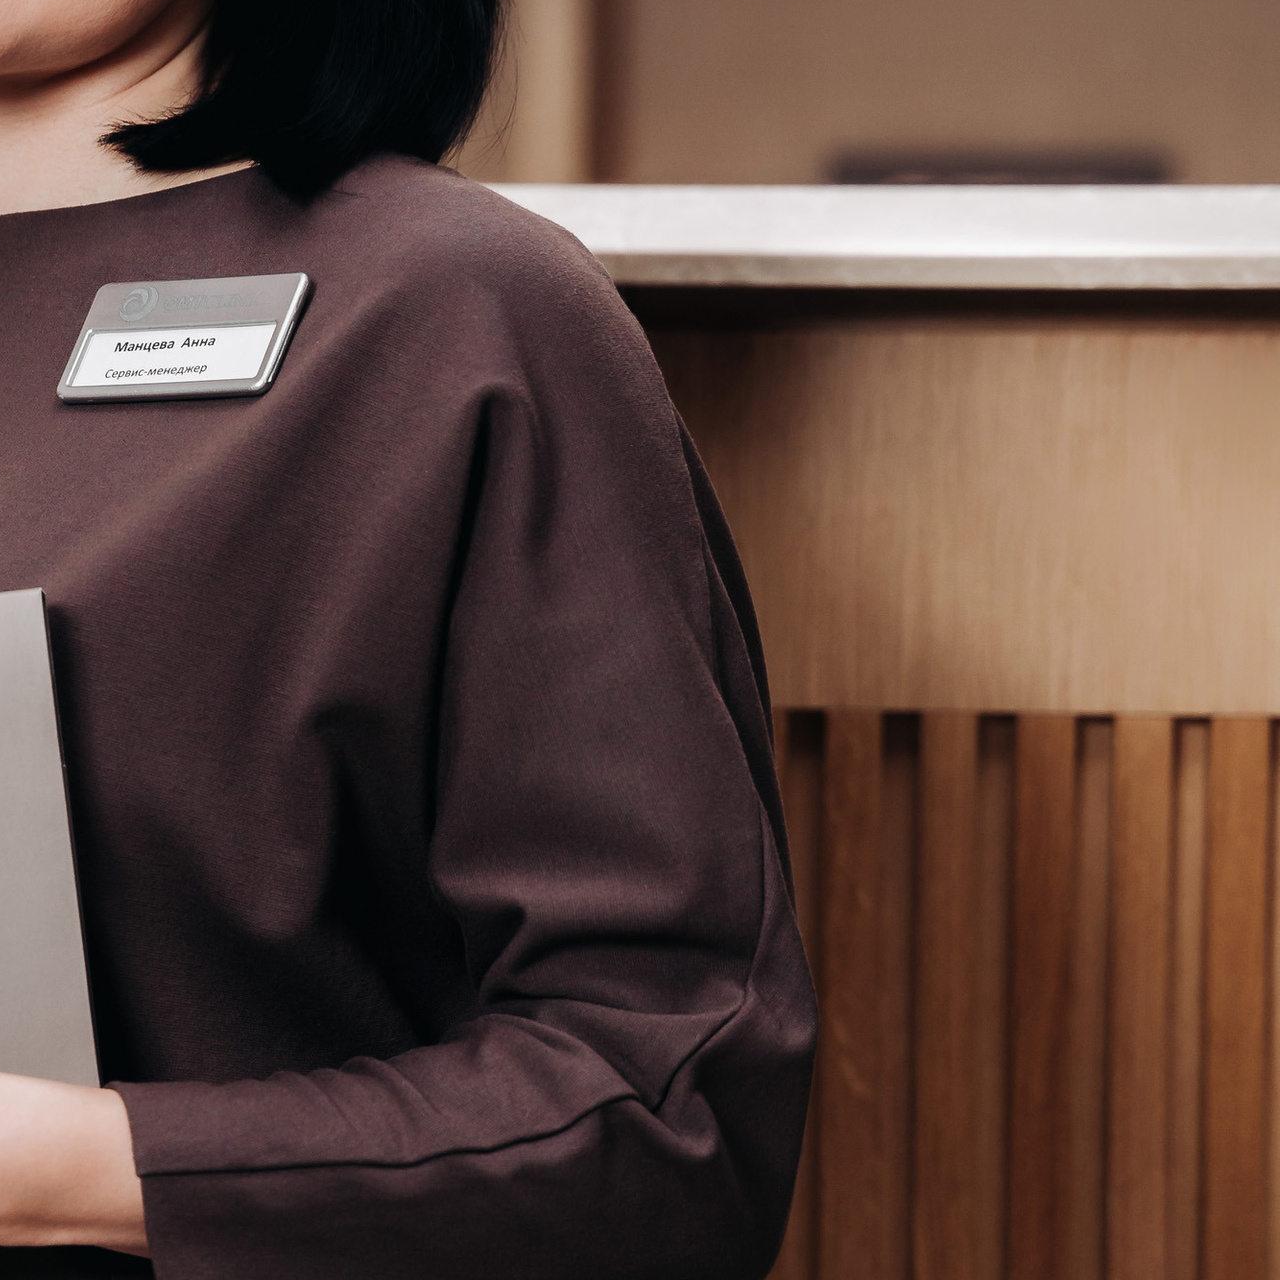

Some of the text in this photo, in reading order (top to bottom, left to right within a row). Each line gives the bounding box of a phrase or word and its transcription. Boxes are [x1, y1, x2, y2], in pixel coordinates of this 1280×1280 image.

[114, 336, 216, 354] Манцева Анна
[104, 363, 208, 380] Сервис-менеджер
